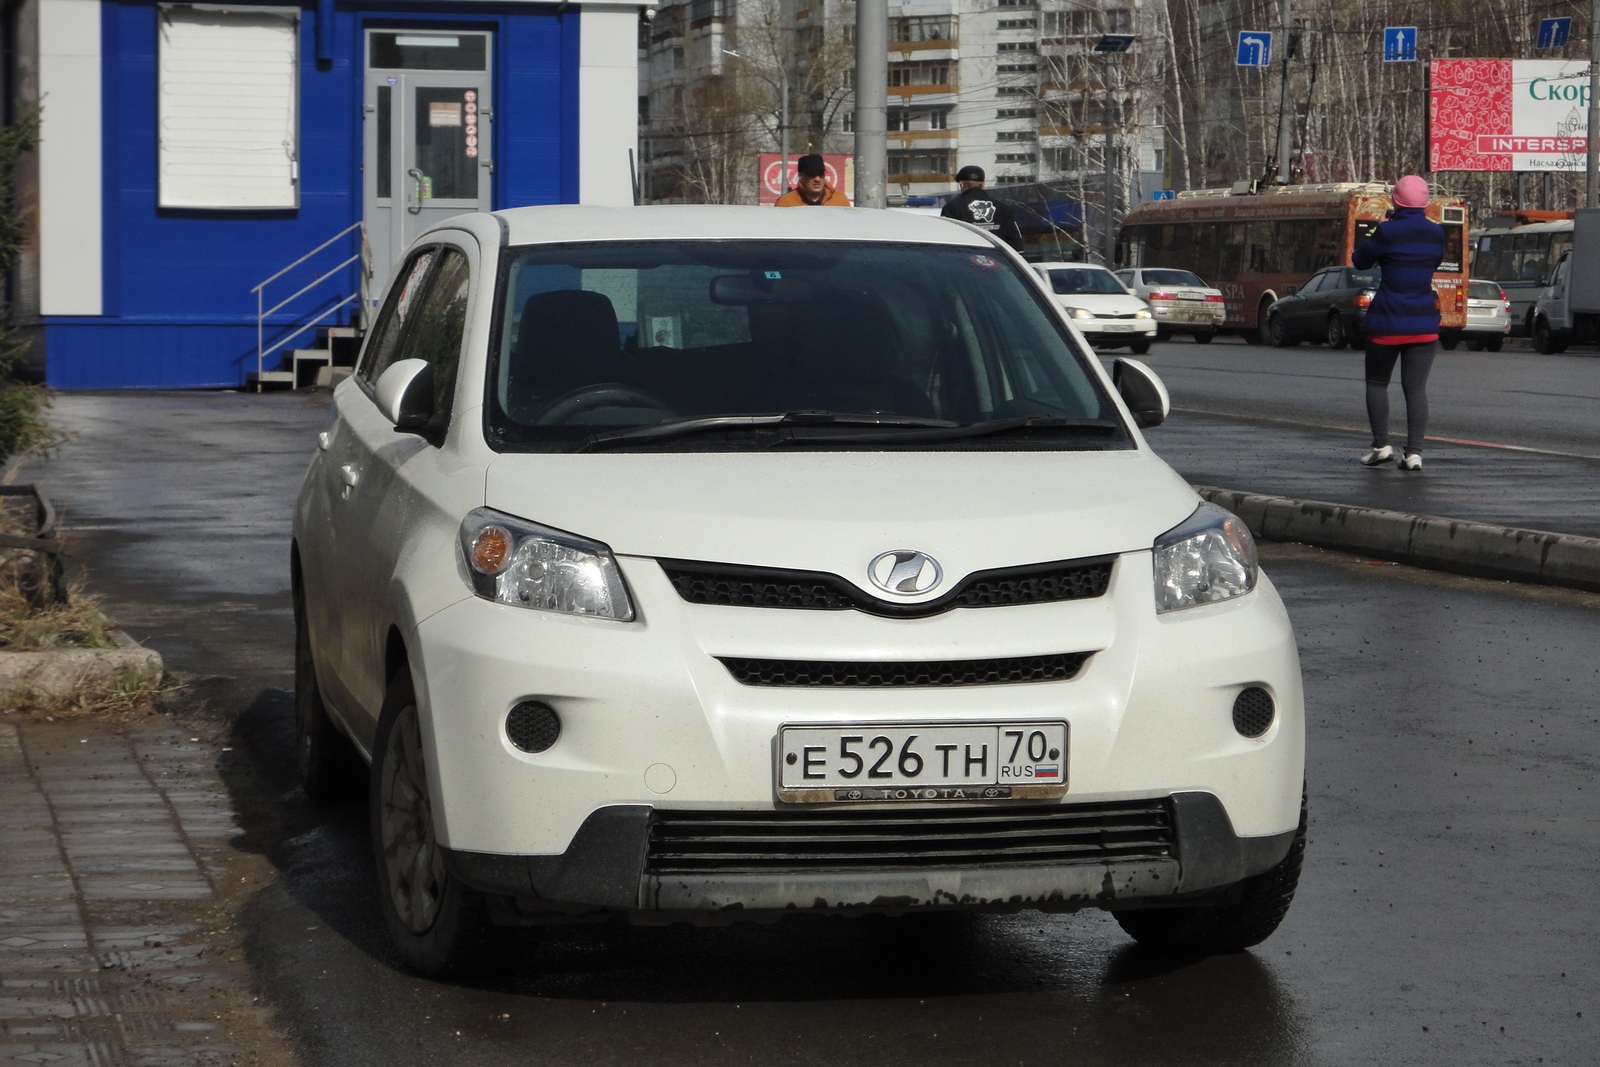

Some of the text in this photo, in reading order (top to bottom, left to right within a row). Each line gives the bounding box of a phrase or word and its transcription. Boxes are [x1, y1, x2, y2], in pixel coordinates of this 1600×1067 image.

[1225, 284, 1245, 299] SPA
[1005, 730, 1047, 763] 70
[1001, 765, 1033, 778] RUS
[881, 788, 966, 800] TOYOTA
